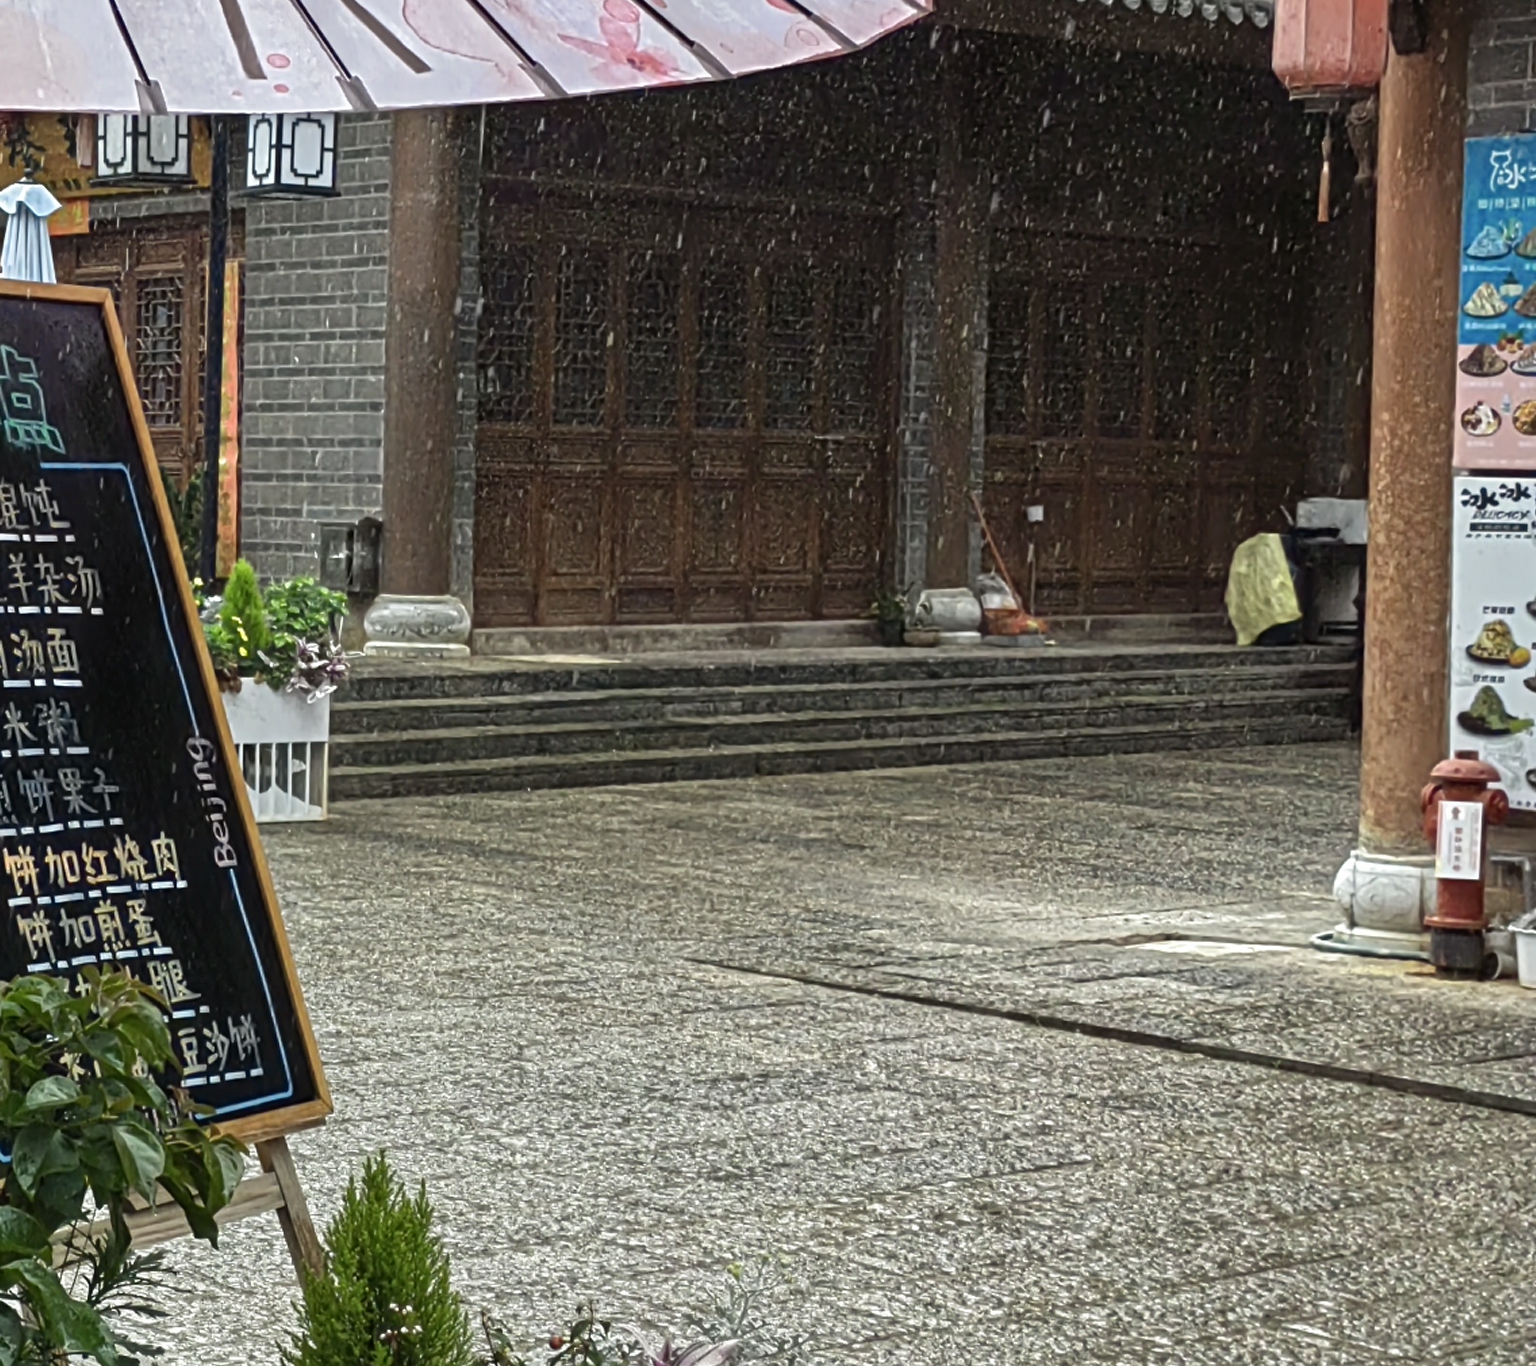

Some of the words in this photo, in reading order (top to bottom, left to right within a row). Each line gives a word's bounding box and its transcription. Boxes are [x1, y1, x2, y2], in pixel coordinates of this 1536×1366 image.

[186, 737, 238, 868] Beijing
[3, 831, 182, 896] 饼加红烧肉
[16, 898, 162, 963] 饼加煎蛋
